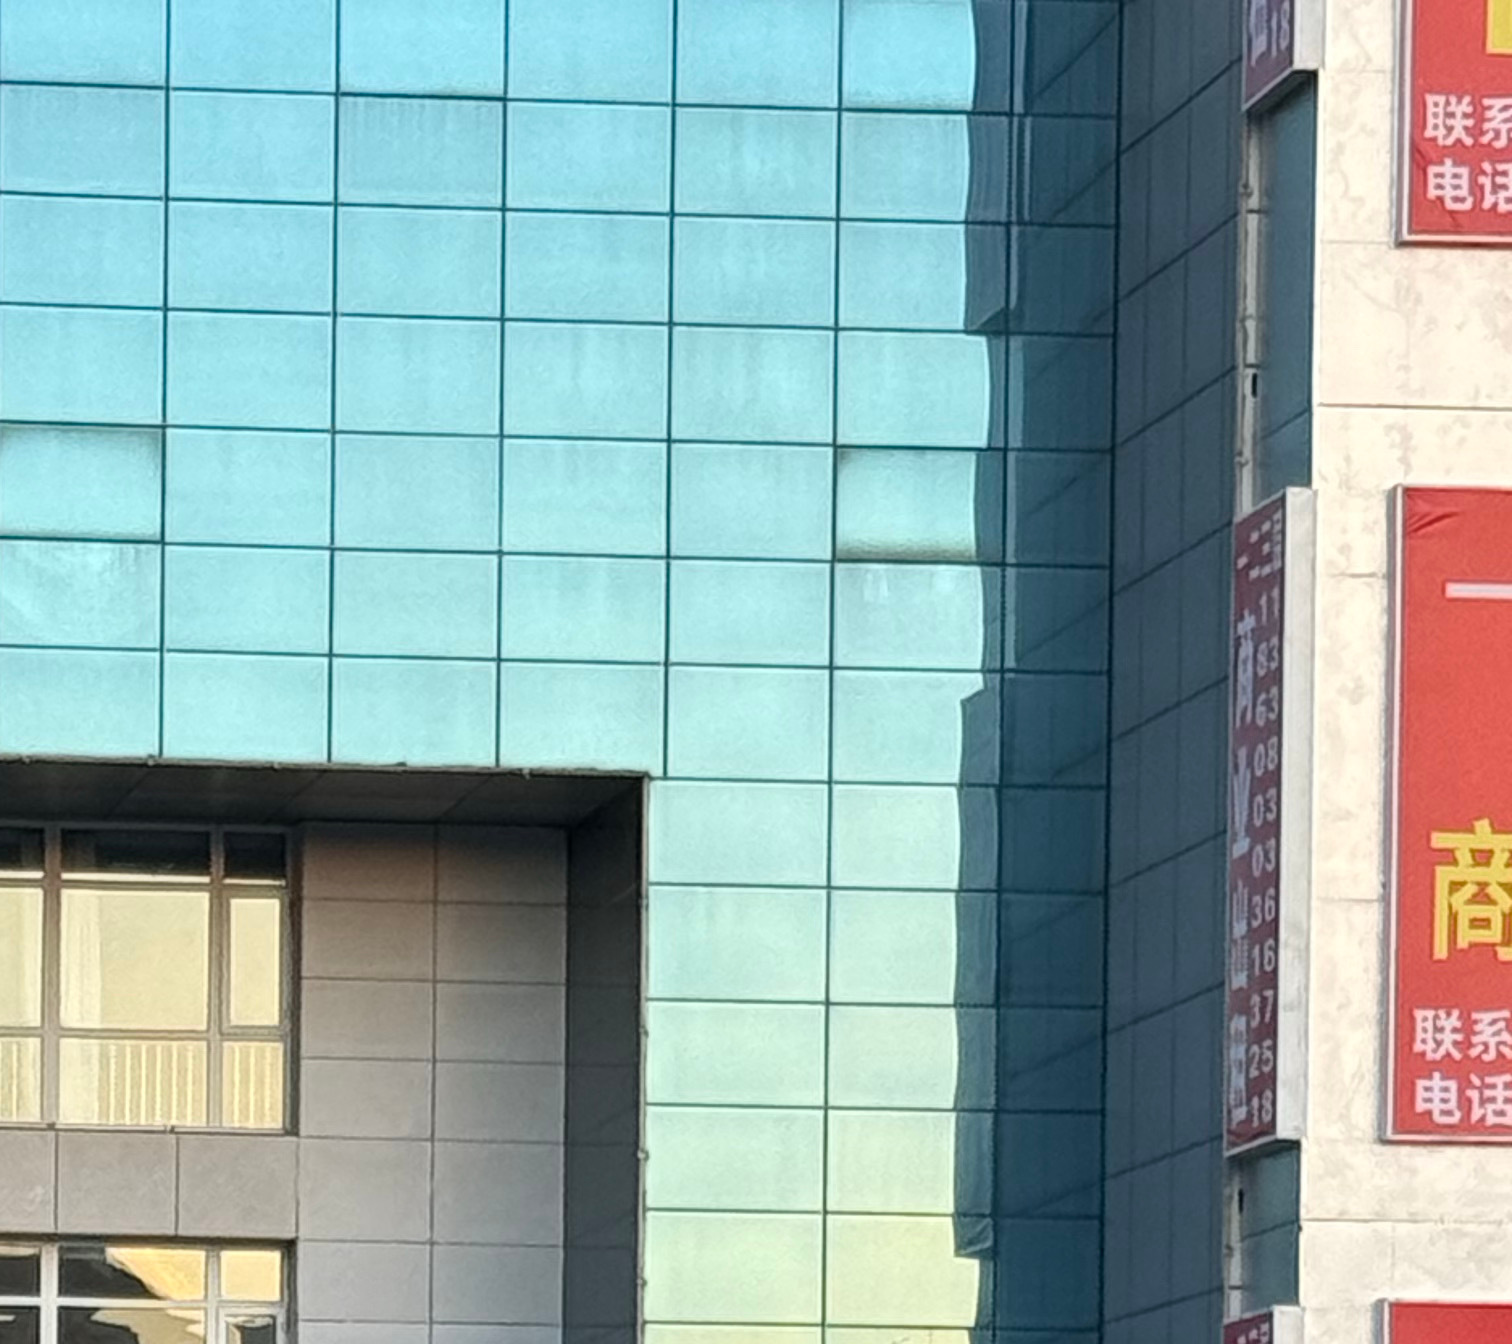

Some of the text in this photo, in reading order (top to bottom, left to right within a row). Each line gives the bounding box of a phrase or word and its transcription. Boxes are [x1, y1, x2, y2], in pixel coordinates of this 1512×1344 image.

[1424, 92, 1512, 149] 联系
[1426, 157, 1512, 213] 电话
[1431, 818, 1512, 961] 商
[1413, 1008, 1512, 1061] 联系
[1414, 1072, 1512, 1126] 电话
